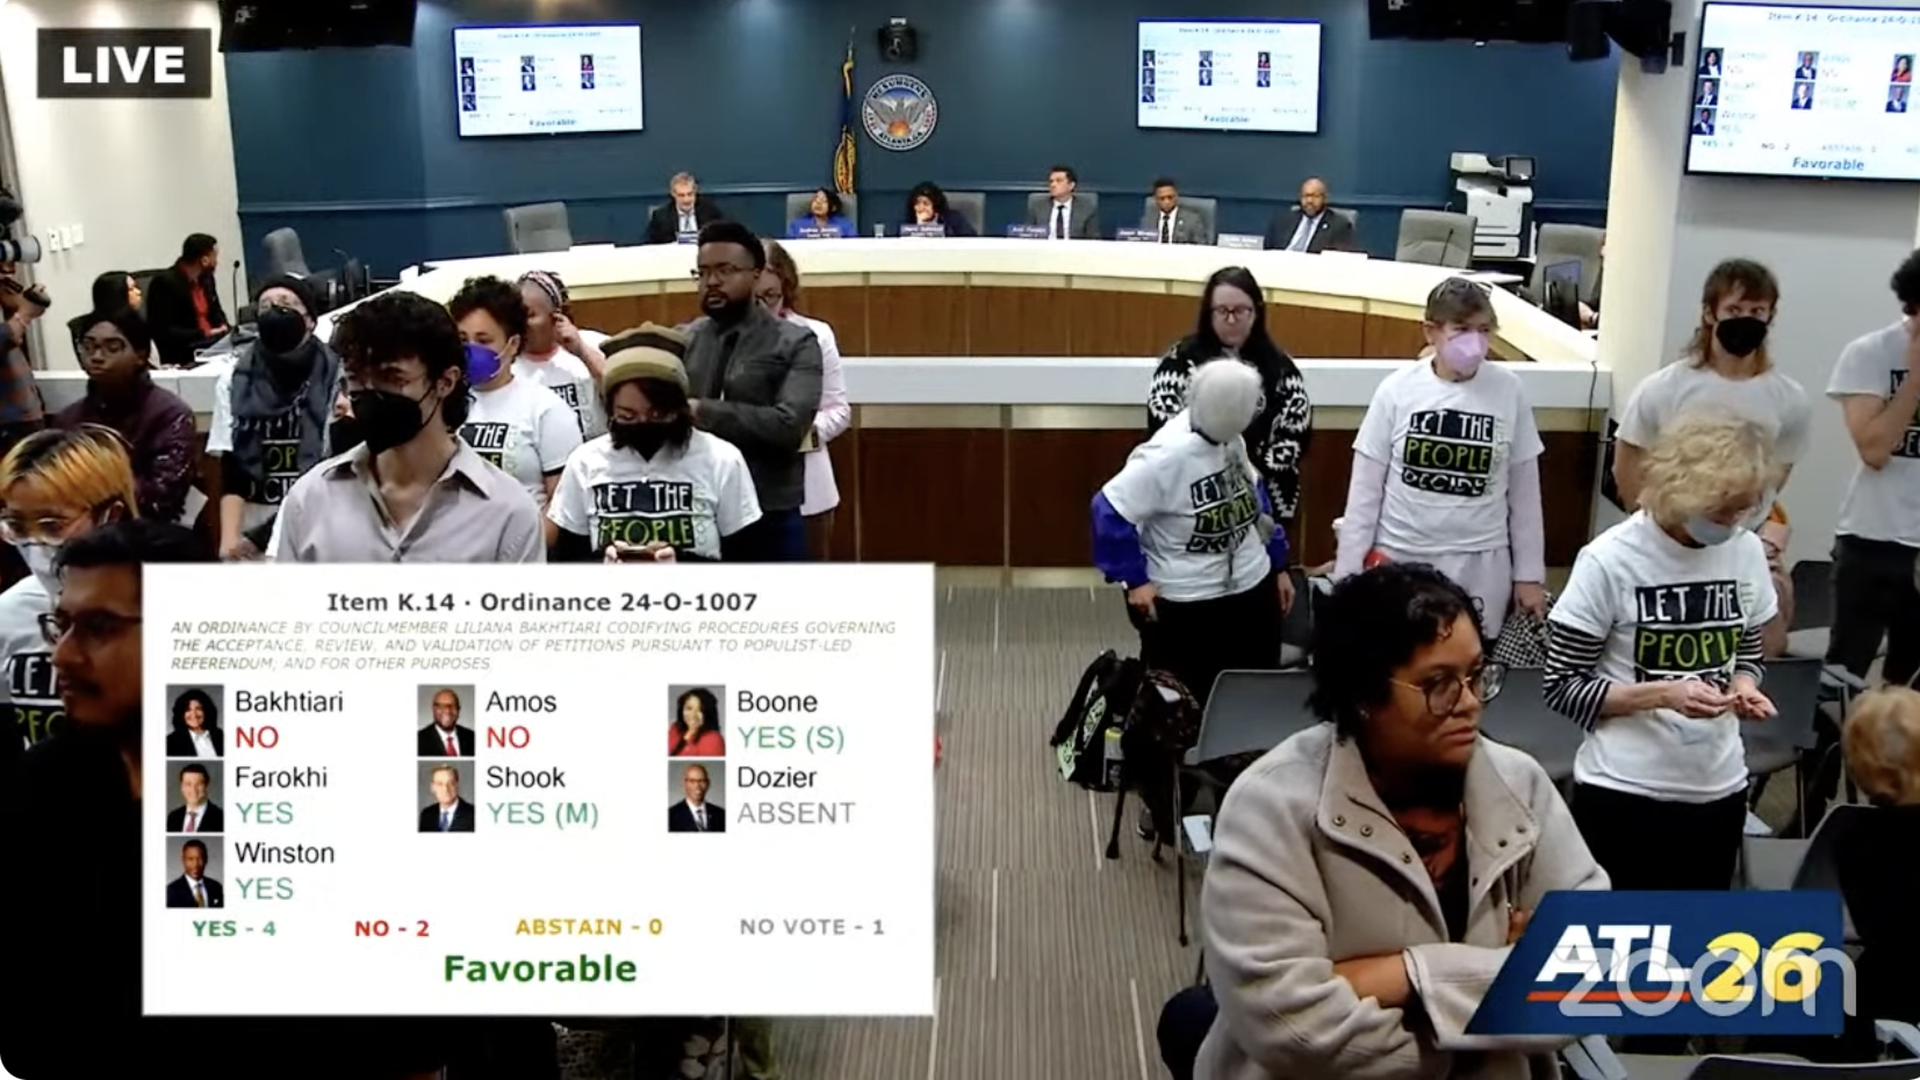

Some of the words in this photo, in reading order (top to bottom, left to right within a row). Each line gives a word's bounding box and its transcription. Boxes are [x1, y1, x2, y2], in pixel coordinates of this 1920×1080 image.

[1791, 156, 1865, 172] Favorable
[473, 424, 507, 447] THE
[1408, 410, 1449, 435] LET
[1458, 413, 1493, 442] THE
[1405, 438, 1490, 472] PEOPLE
[597, 484, 637, 513] LET
[649, 483, 690, 512] THE
[1639, 585, 1690, 623] LET
[1704, 583, 1739, 620] THE
